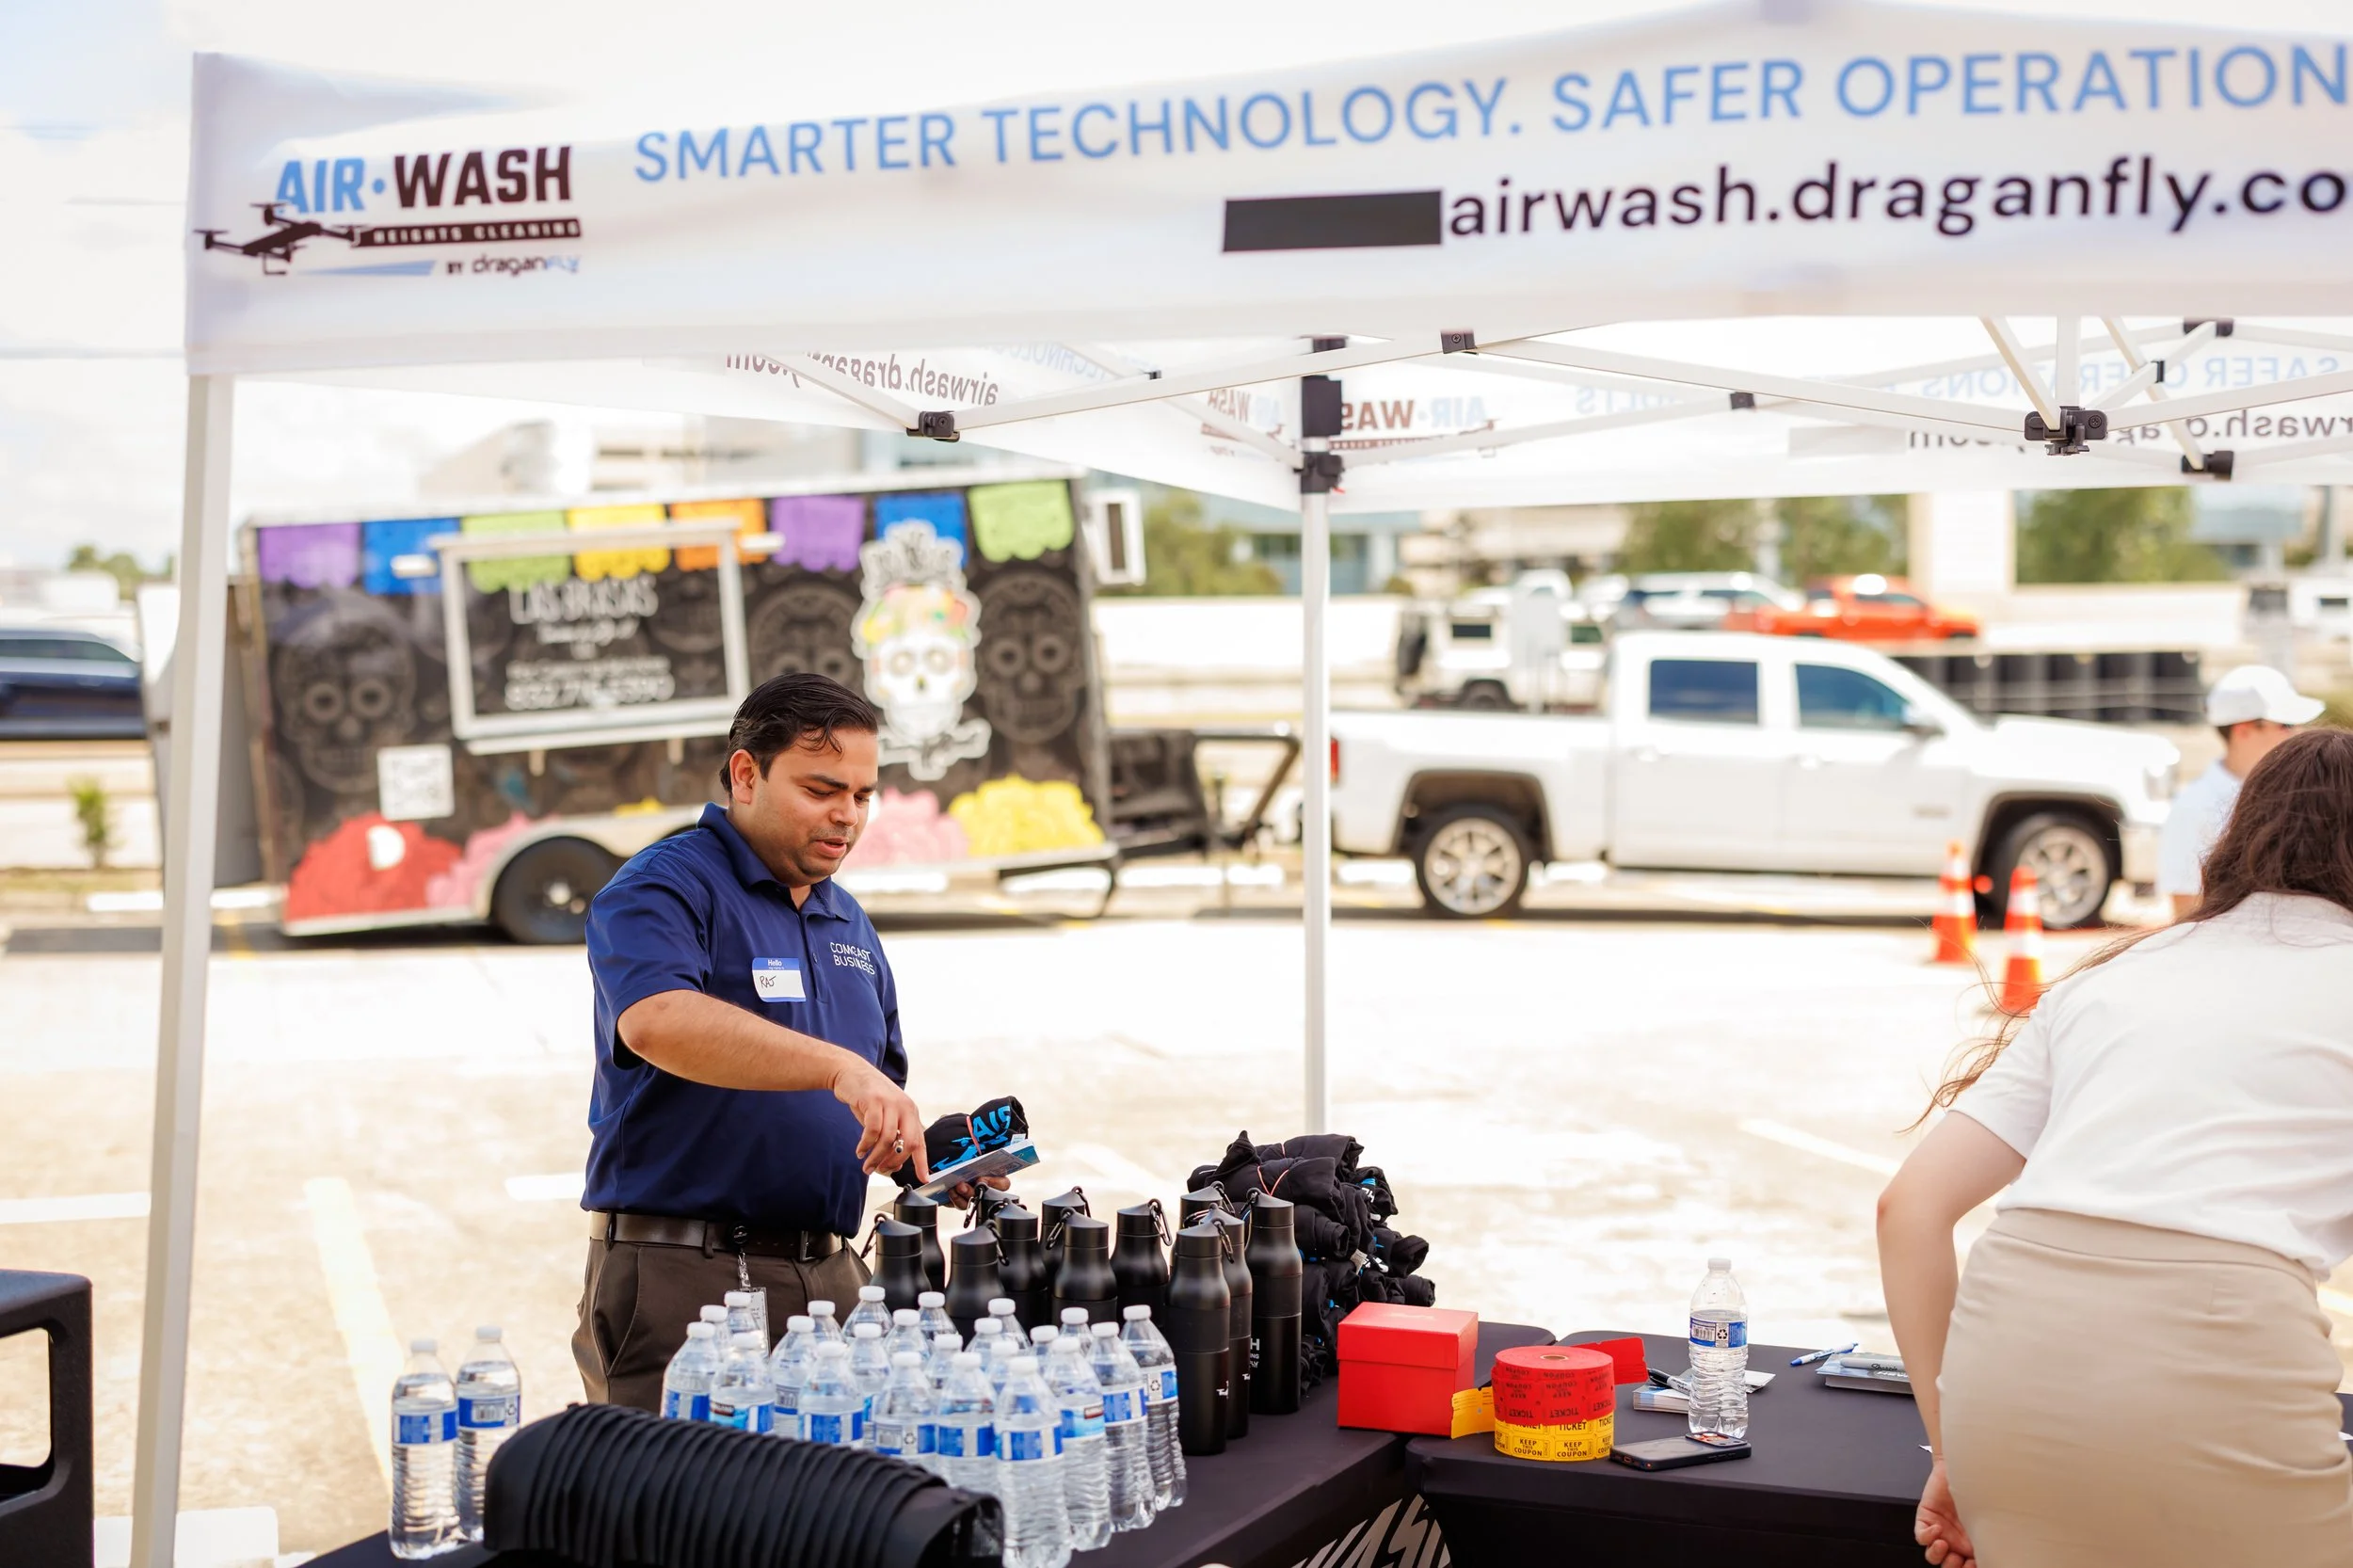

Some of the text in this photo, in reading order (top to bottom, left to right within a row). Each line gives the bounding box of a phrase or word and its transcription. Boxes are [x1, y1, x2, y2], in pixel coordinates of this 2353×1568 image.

[634, 114, 956, 184] SMARTER
[982, 78, 1522, 166] TECHNOLOGY.
[1553, 57, 1804, 134] SAFER
[830, 941, 872, 962] COMCAST
[833, 954, 875, 975] BUSINESS
[1550, 1407, 1579, 1418] TICKET
[1560, 1421, 1587, 1432] TICKET
[1519, 1438, 1537, 1447] KEEP
[1513, 1447, 1543, 1457] COUPON
